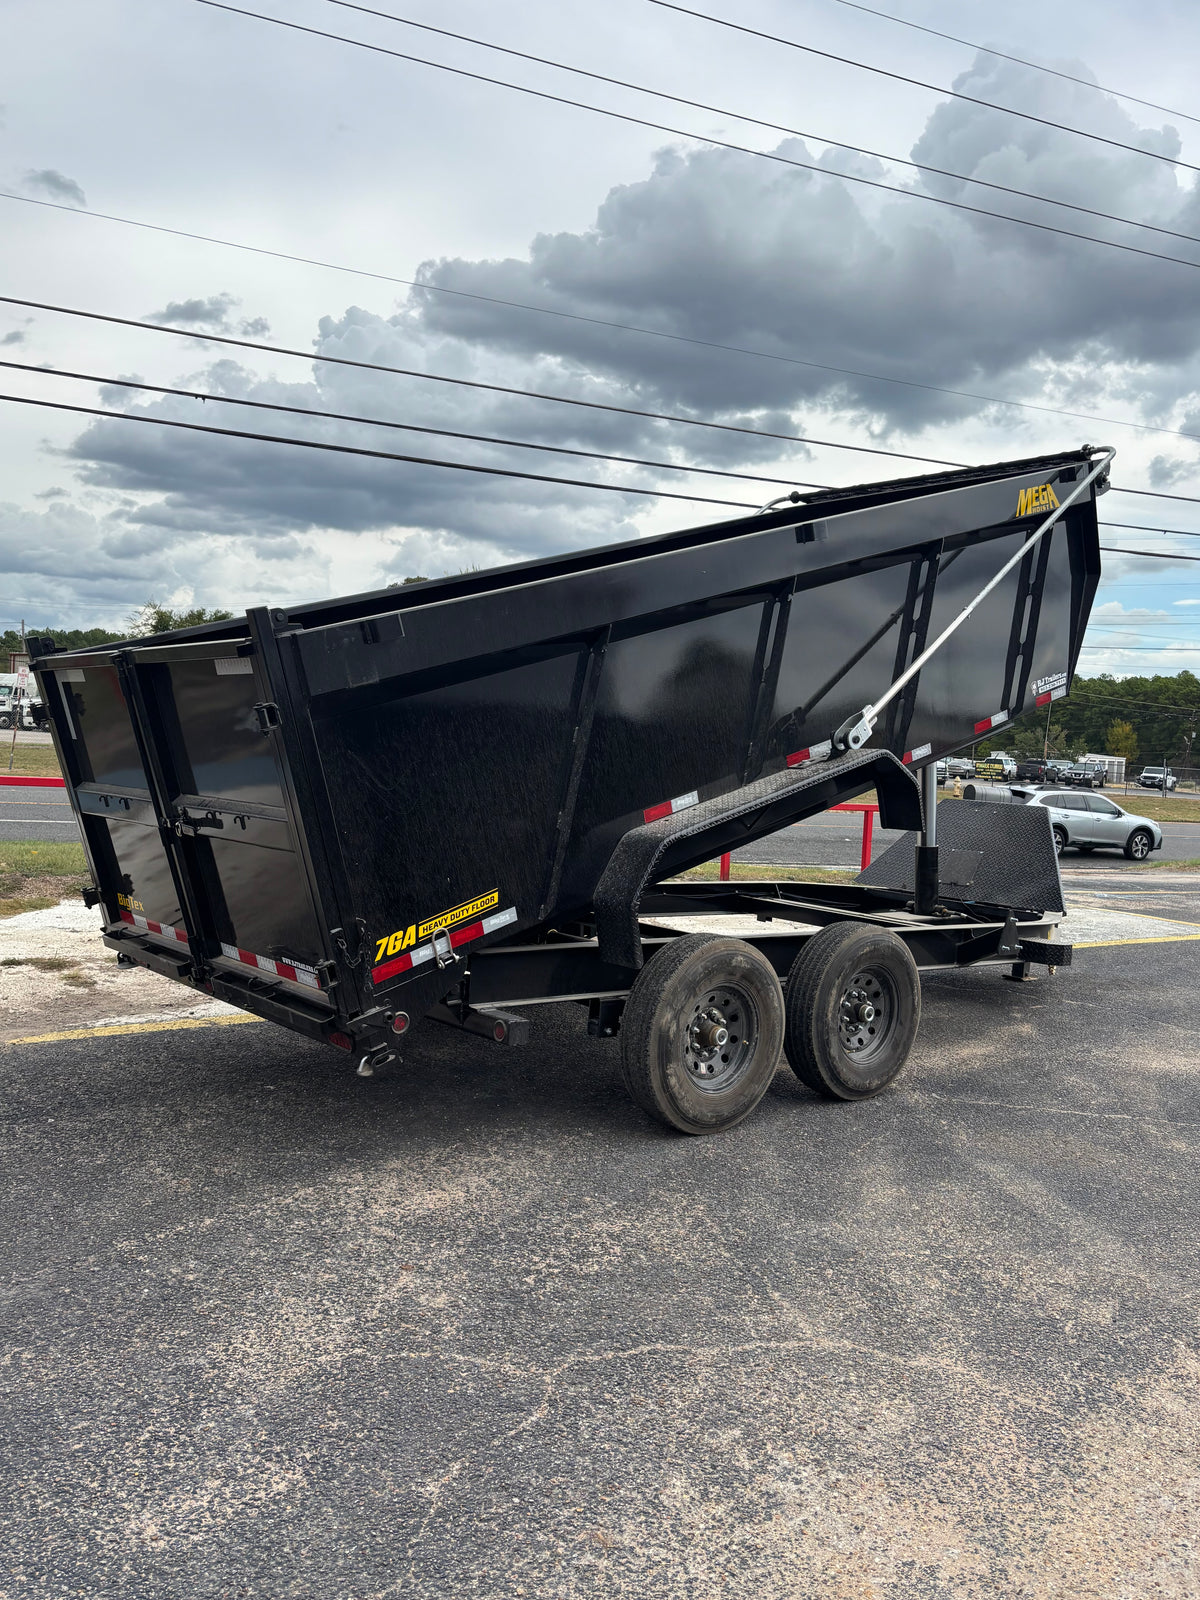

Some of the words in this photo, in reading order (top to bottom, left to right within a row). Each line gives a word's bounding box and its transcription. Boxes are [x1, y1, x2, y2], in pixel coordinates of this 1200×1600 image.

[1015, 483, 1060, 518] MEGA
[117, 892, 144, 912] BigTex
[374, 924, 416, 962] 7GA
[422, 916, 449, 934] HEAVY
[450, 906, 471, 922] DUTY
[471, 895, 496, 912] FLOOR
